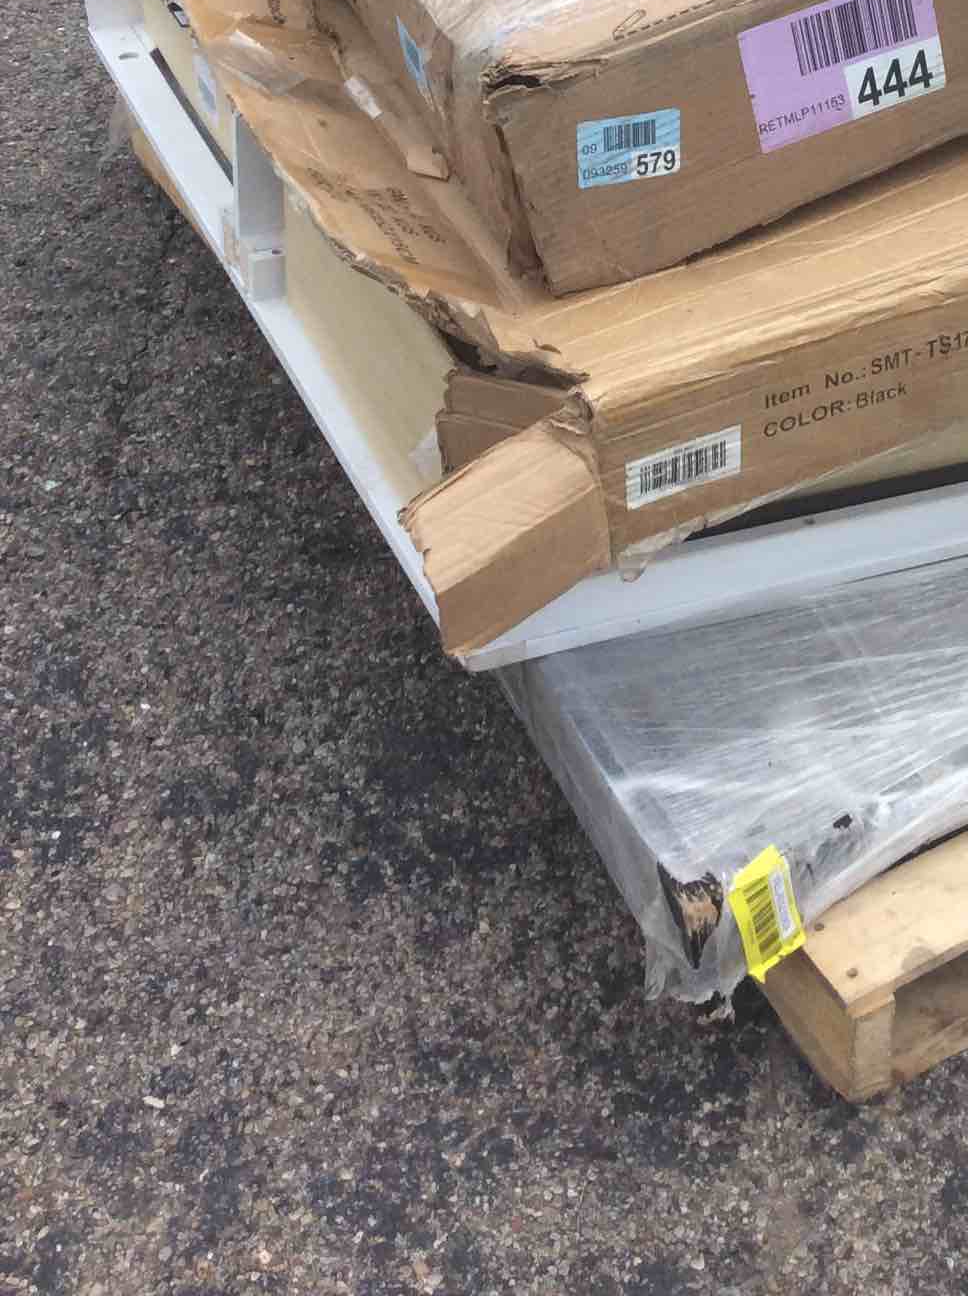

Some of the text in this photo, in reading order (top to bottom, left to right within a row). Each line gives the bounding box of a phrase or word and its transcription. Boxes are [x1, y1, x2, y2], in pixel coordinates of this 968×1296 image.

[858, 48, 934, 107] 444
[582, 143, 598, 155] 09
[636, 149, 676, 176] 579
[764, 384, 811, 409] Item
[856, 381, 908, 409] Black
